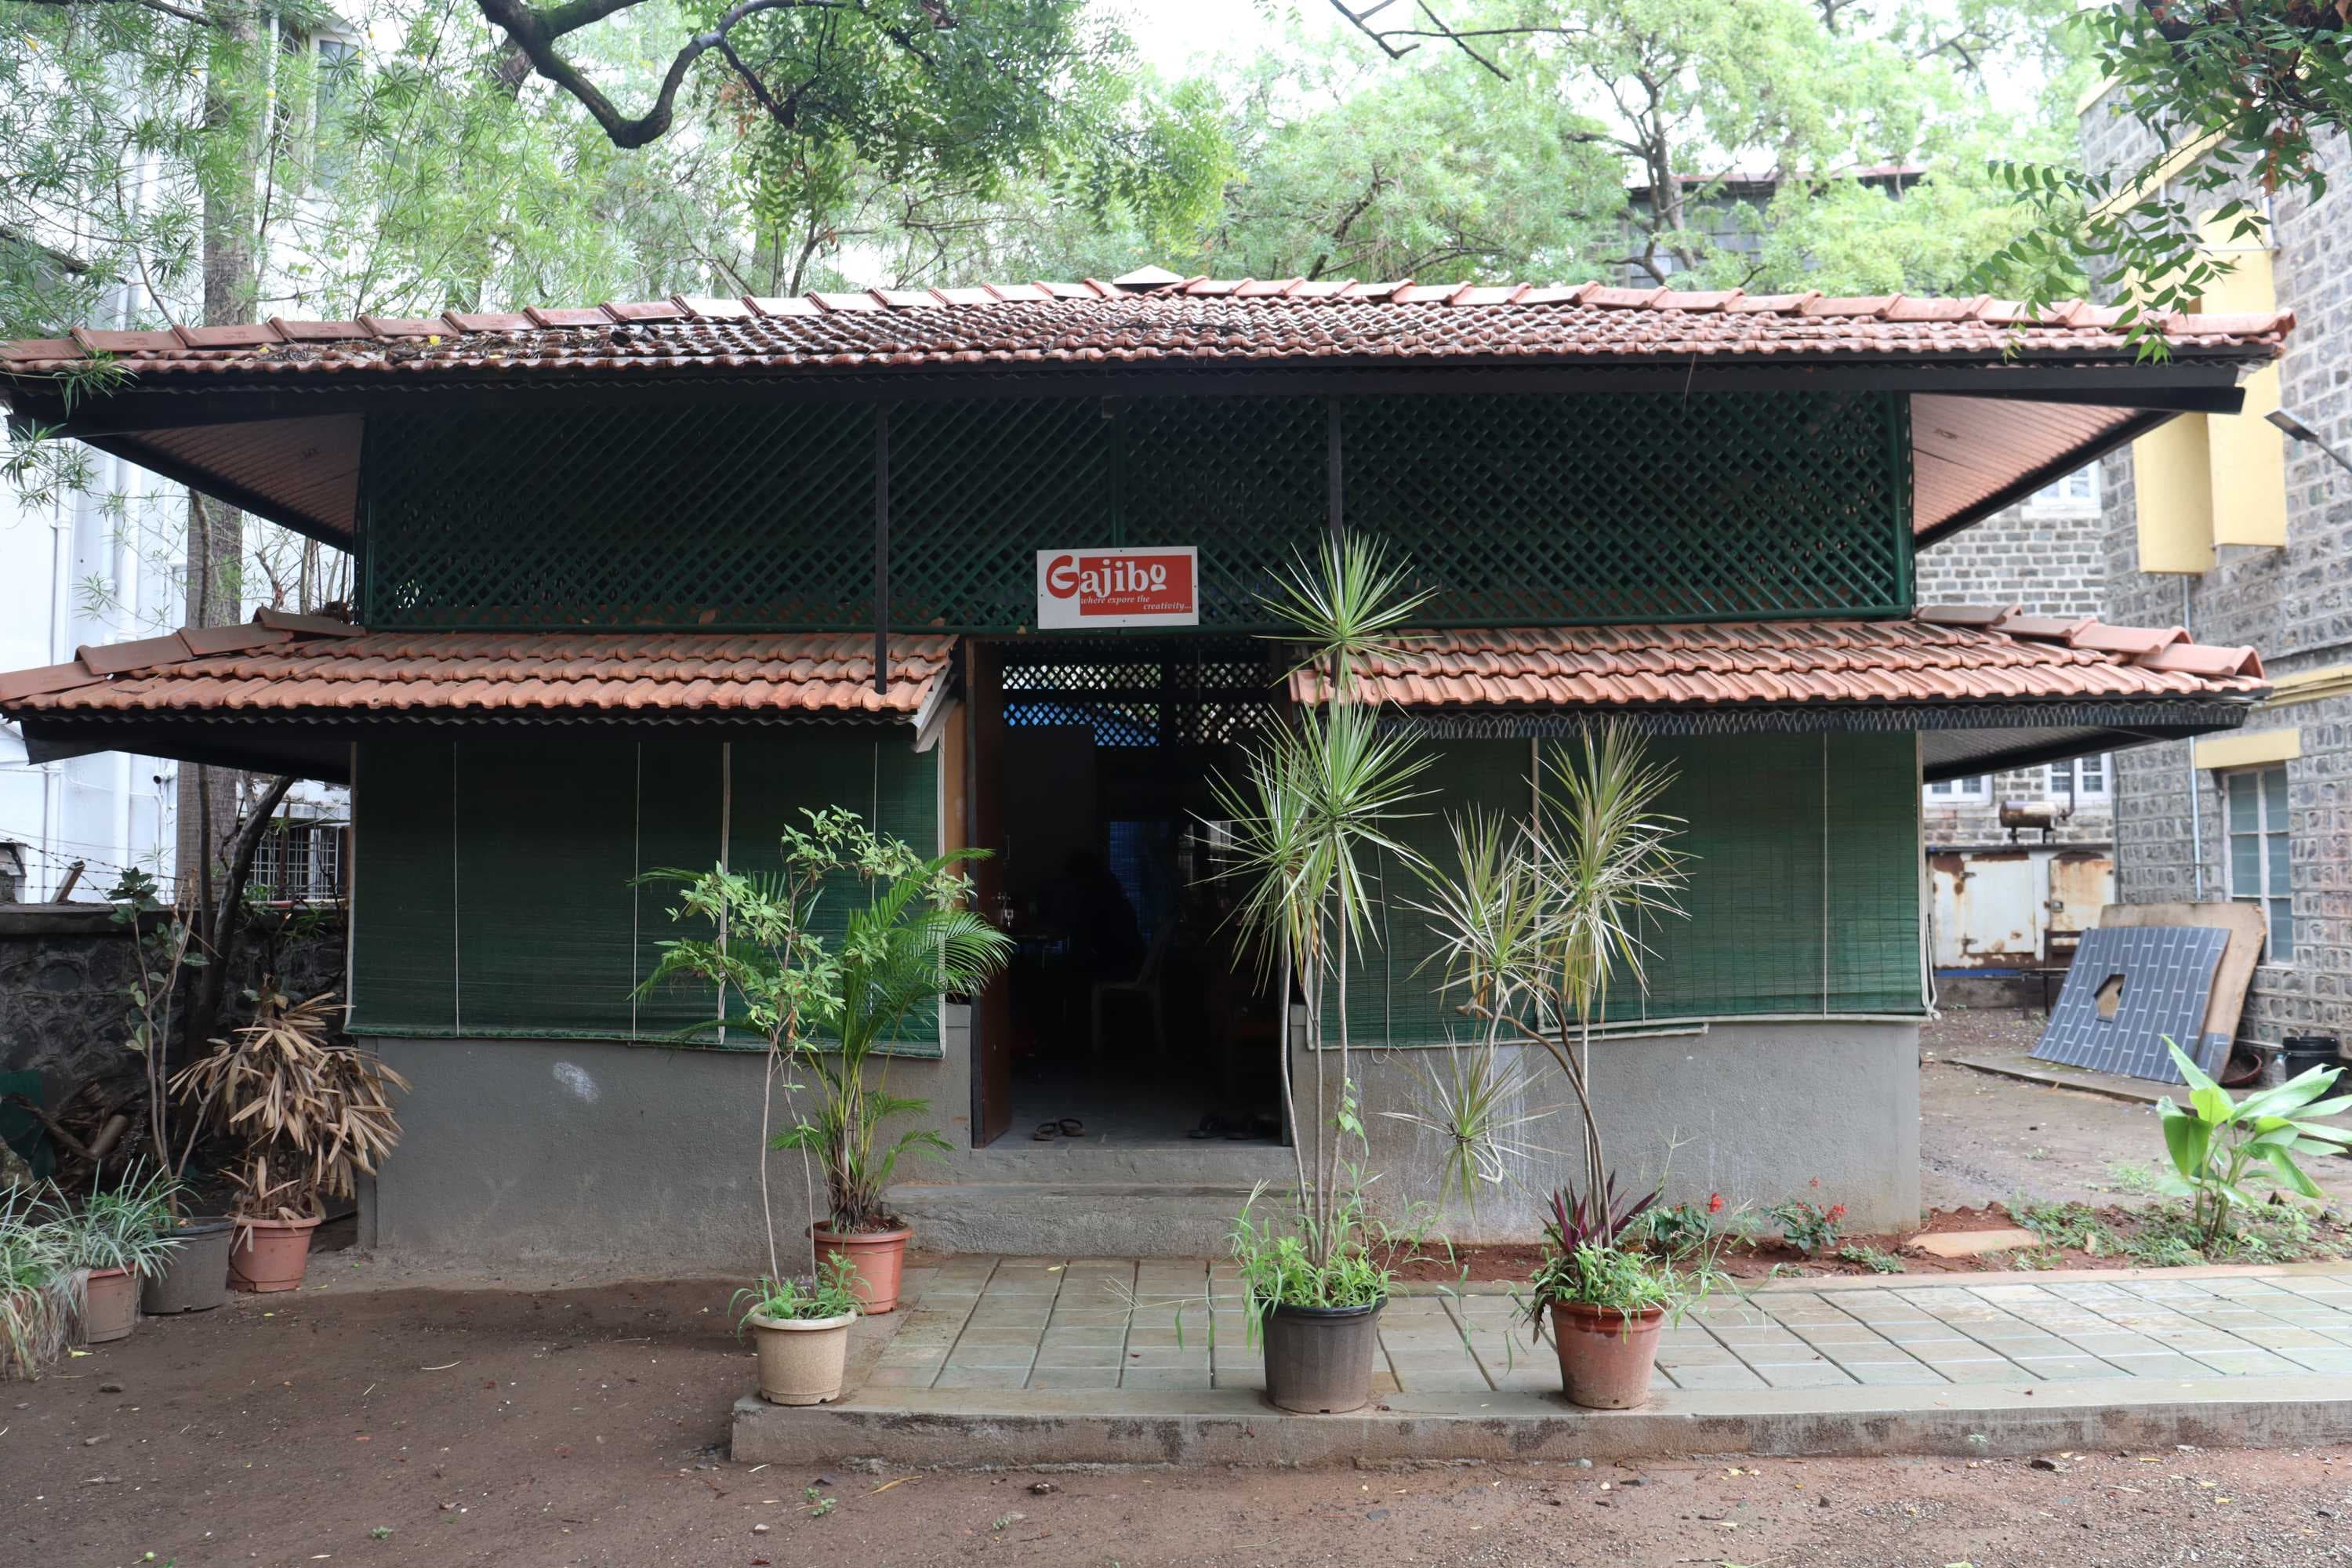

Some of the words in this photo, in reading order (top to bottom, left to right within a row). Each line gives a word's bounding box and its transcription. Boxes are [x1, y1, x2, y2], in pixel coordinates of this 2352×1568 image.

[1046, 554, 1167, 599] Gajibo
[1080, 596, 1105, 604] where
[1137, 595, 1150, 604] the
